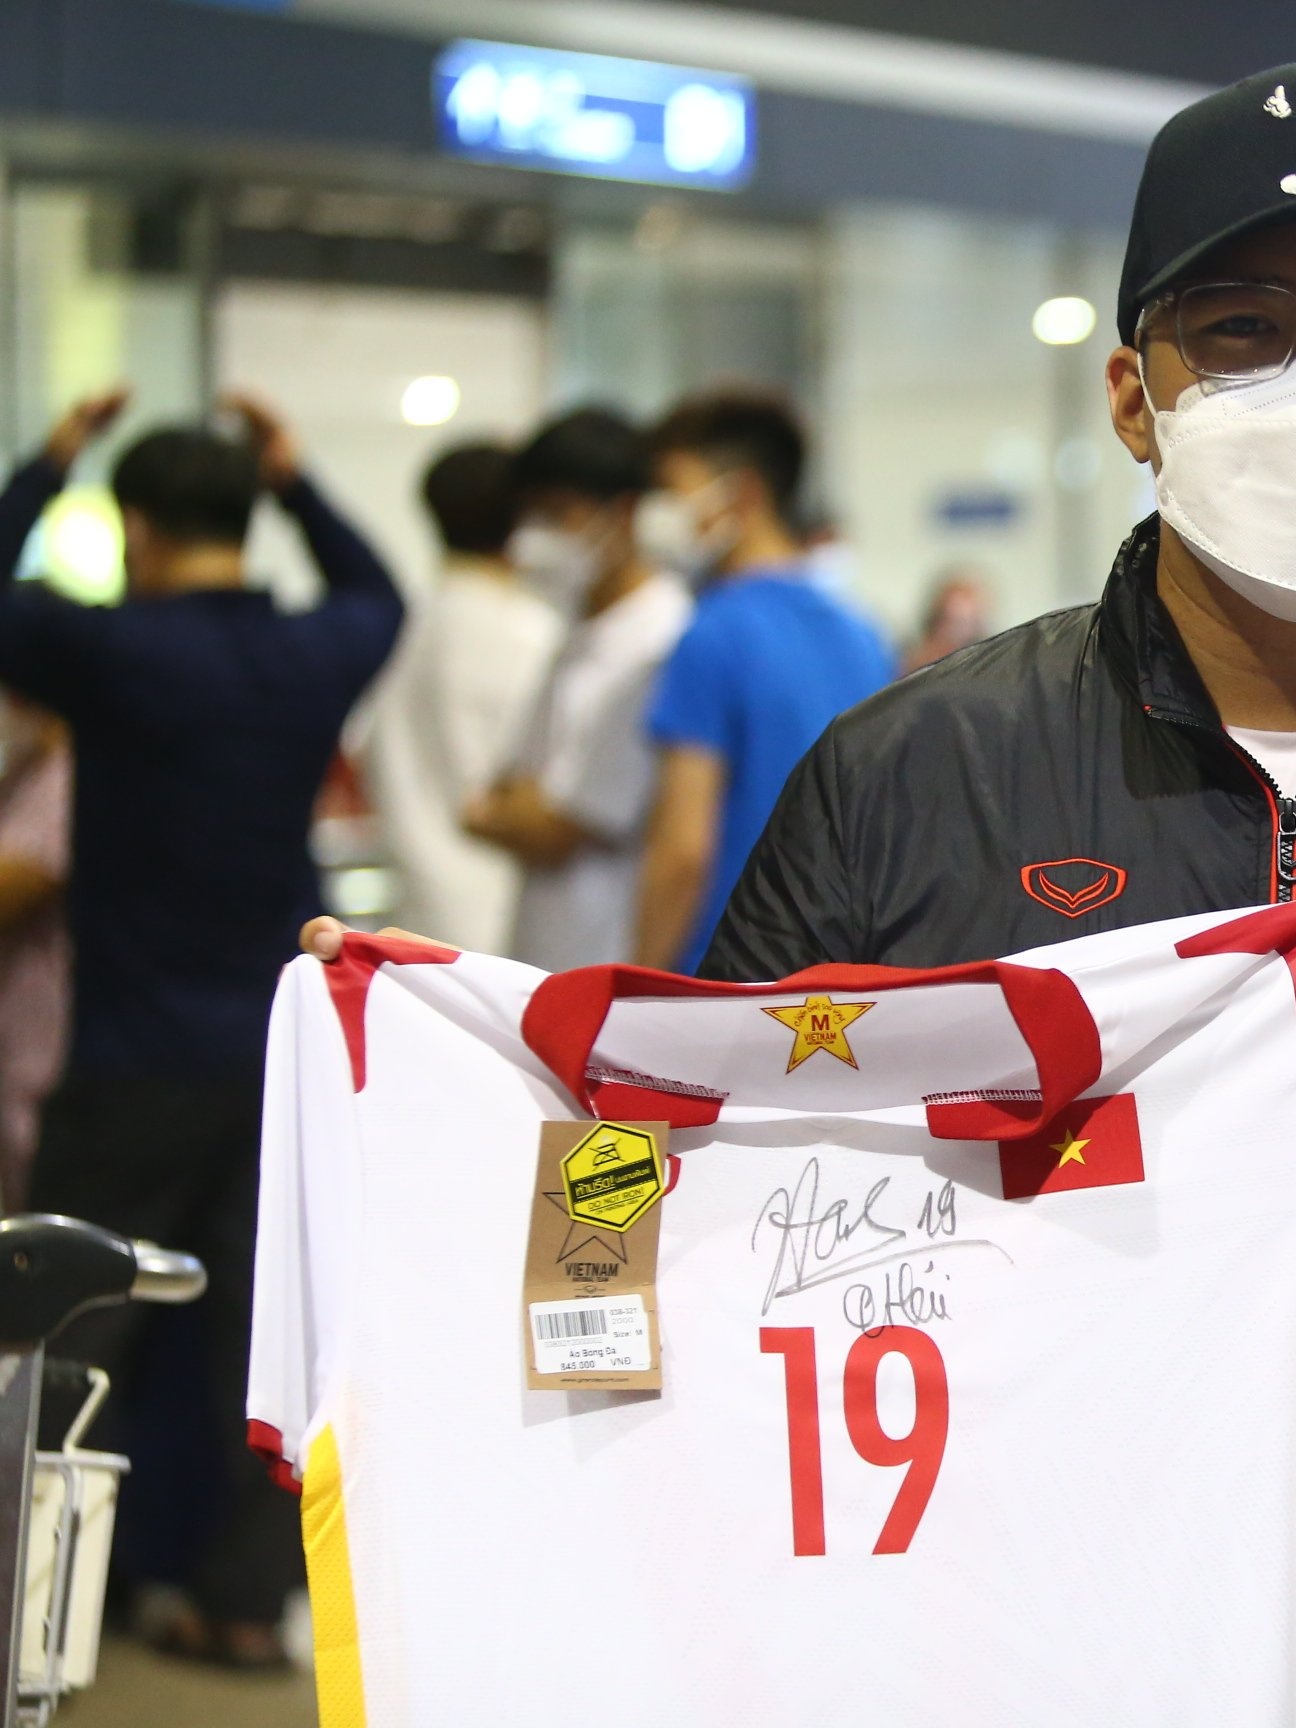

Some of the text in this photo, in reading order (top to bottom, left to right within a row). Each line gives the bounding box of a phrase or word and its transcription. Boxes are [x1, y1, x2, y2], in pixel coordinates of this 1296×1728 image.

[811, 1014, 830, 1031] M
[804, 1032, 837, 1042] VIETNAM
[588, 1200, 601, 1210] DO
[604, 1194, 620, 1205] NOT
[565, 1263, 619, 1277] VIETNAM
[759, 1324, 950, 1556] 19
